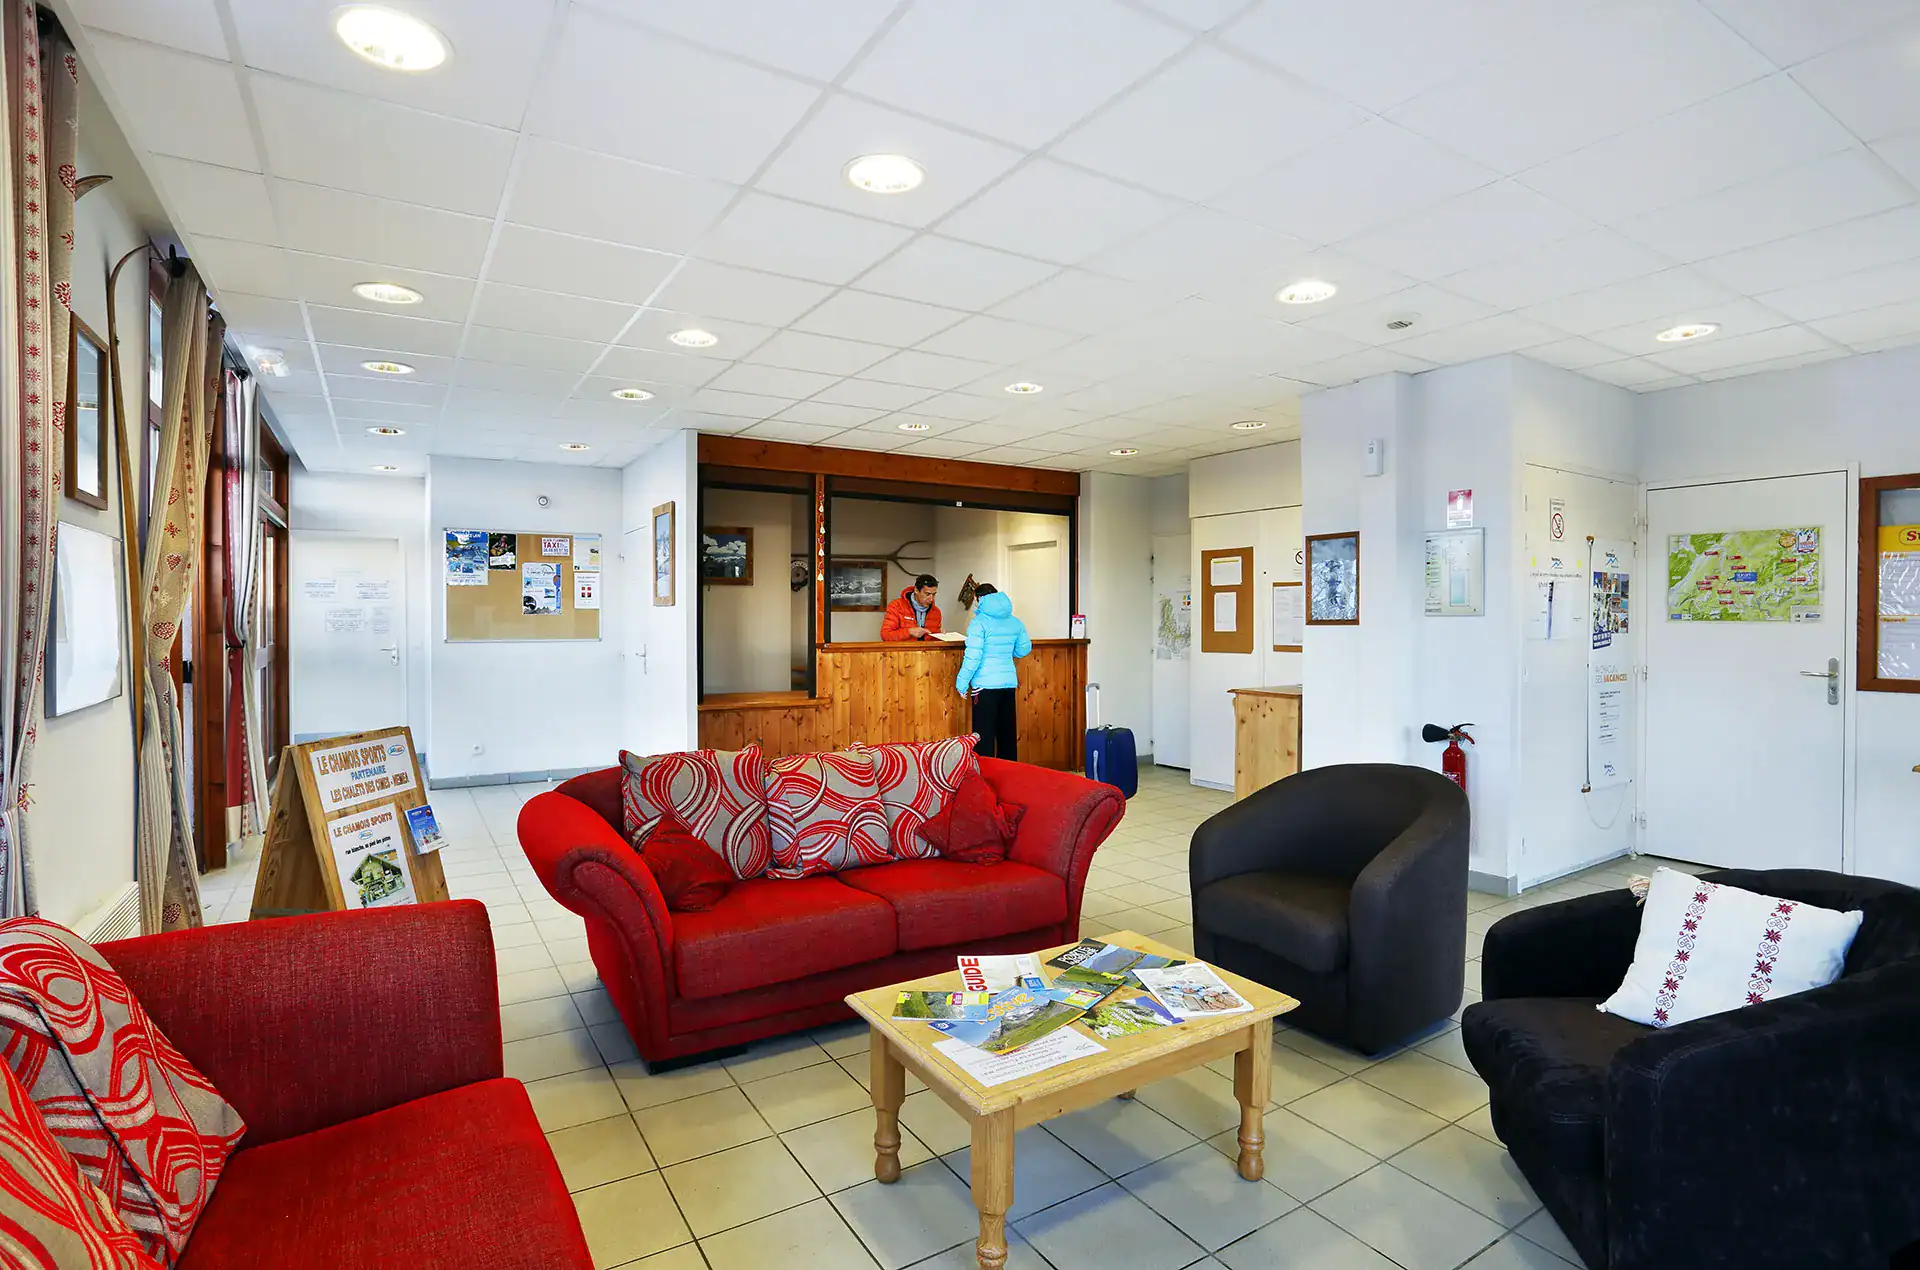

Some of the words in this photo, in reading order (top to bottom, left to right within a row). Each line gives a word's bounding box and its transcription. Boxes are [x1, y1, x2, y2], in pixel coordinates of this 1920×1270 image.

[1603, 673, 1628, 683] VACANCES
[317, 755, 329, 776] LE
[328, 749, 361, 773] CHAMOIS
[360, 744, 387, 766] SPORTS
[350, 765, 387, 780] PARTENAIRE
[330, 788, 342, 803] LES
[342, 782, 365, 800] CHALETS
[364, 779, 376, 795] DES
[333, 828, 342, 838] LE
[342, 818, 371, 835] CHAMOIS
[370, 811, 393, 827] SPORTS
[960, 957, 989, 992] GUIDE
